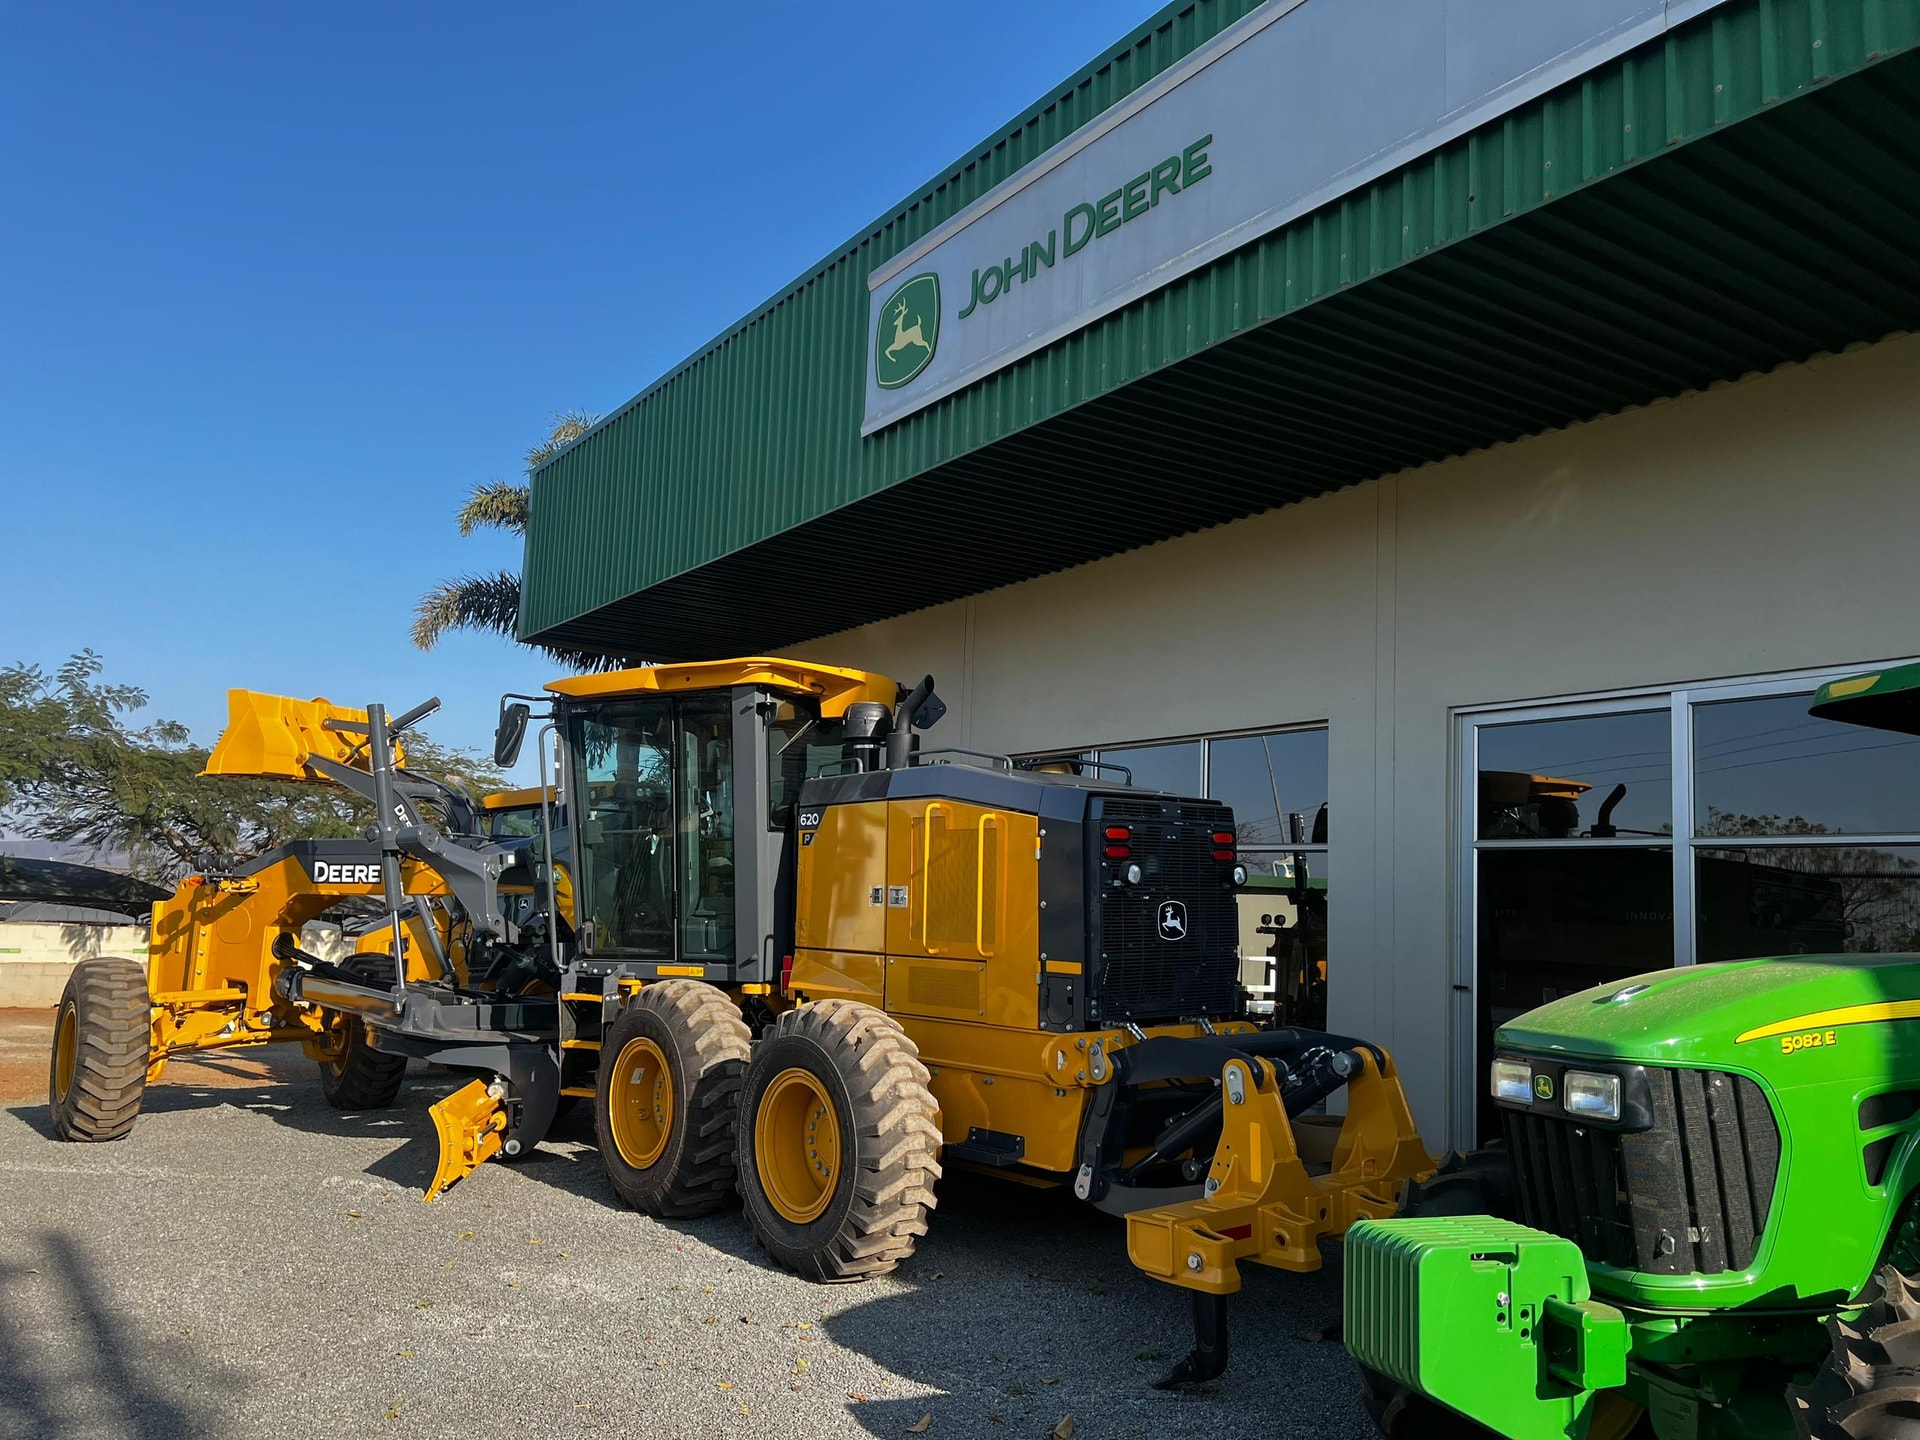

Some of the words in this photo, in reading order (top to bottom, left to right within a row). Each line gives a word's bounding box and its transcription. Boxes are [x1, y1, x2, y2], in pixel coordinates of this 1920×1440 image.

[958, 230, 1055, 320] JOHN
[1063, 133, 1213, 259] DEERE
[800, 813, 820, 826] 620
[804, 834, 811, 844] P
[313, 861, 381, 883] DEERE
[1781, 1032, 1823, 1055] 5082
[1825, 1030, 1836, 1045] E
